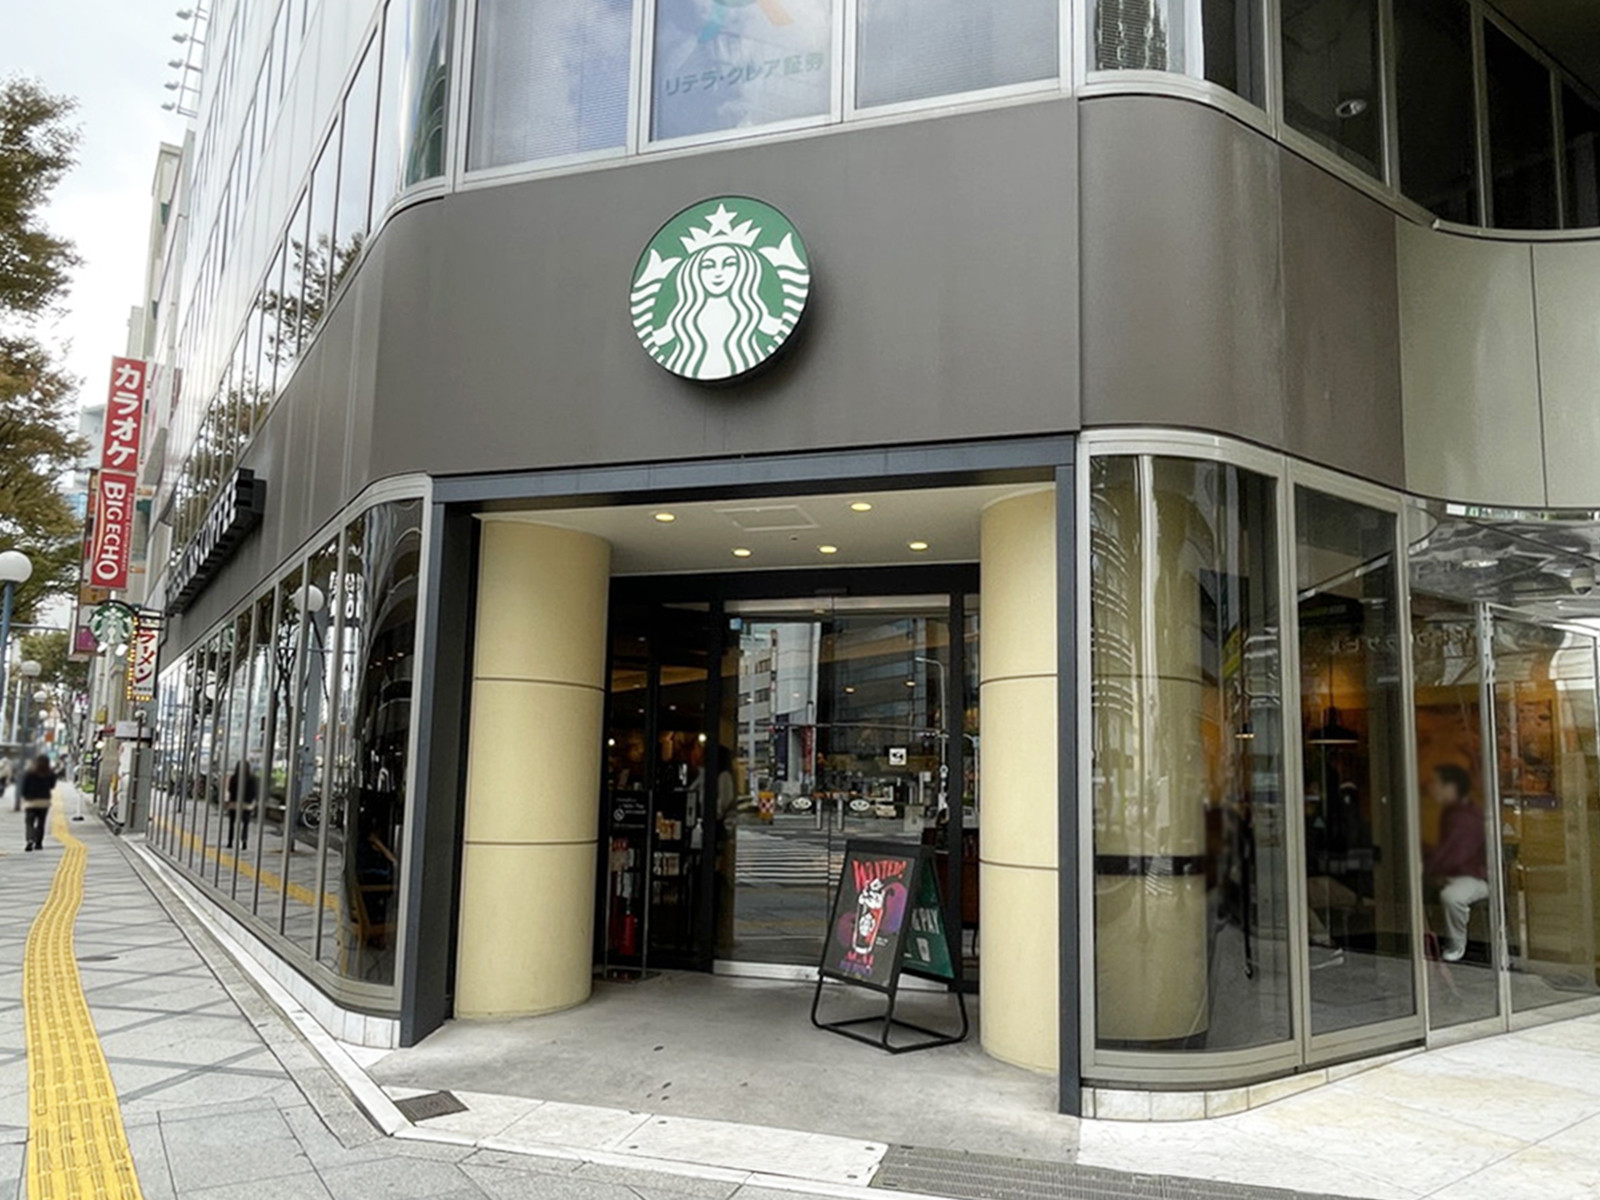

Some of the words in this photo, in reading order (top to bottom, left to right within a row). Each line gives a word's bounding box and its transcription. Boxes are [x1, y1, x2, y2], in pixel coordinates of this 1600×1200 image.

[665, 51, 825, 97] リテラ・クレア証券
[106, 365, 139, 466] カラオケ
[103, 481, 128, 526] BIG
[95, 526, 121, 581] ECHO
[134, 628, 156, 684] ラーメン
